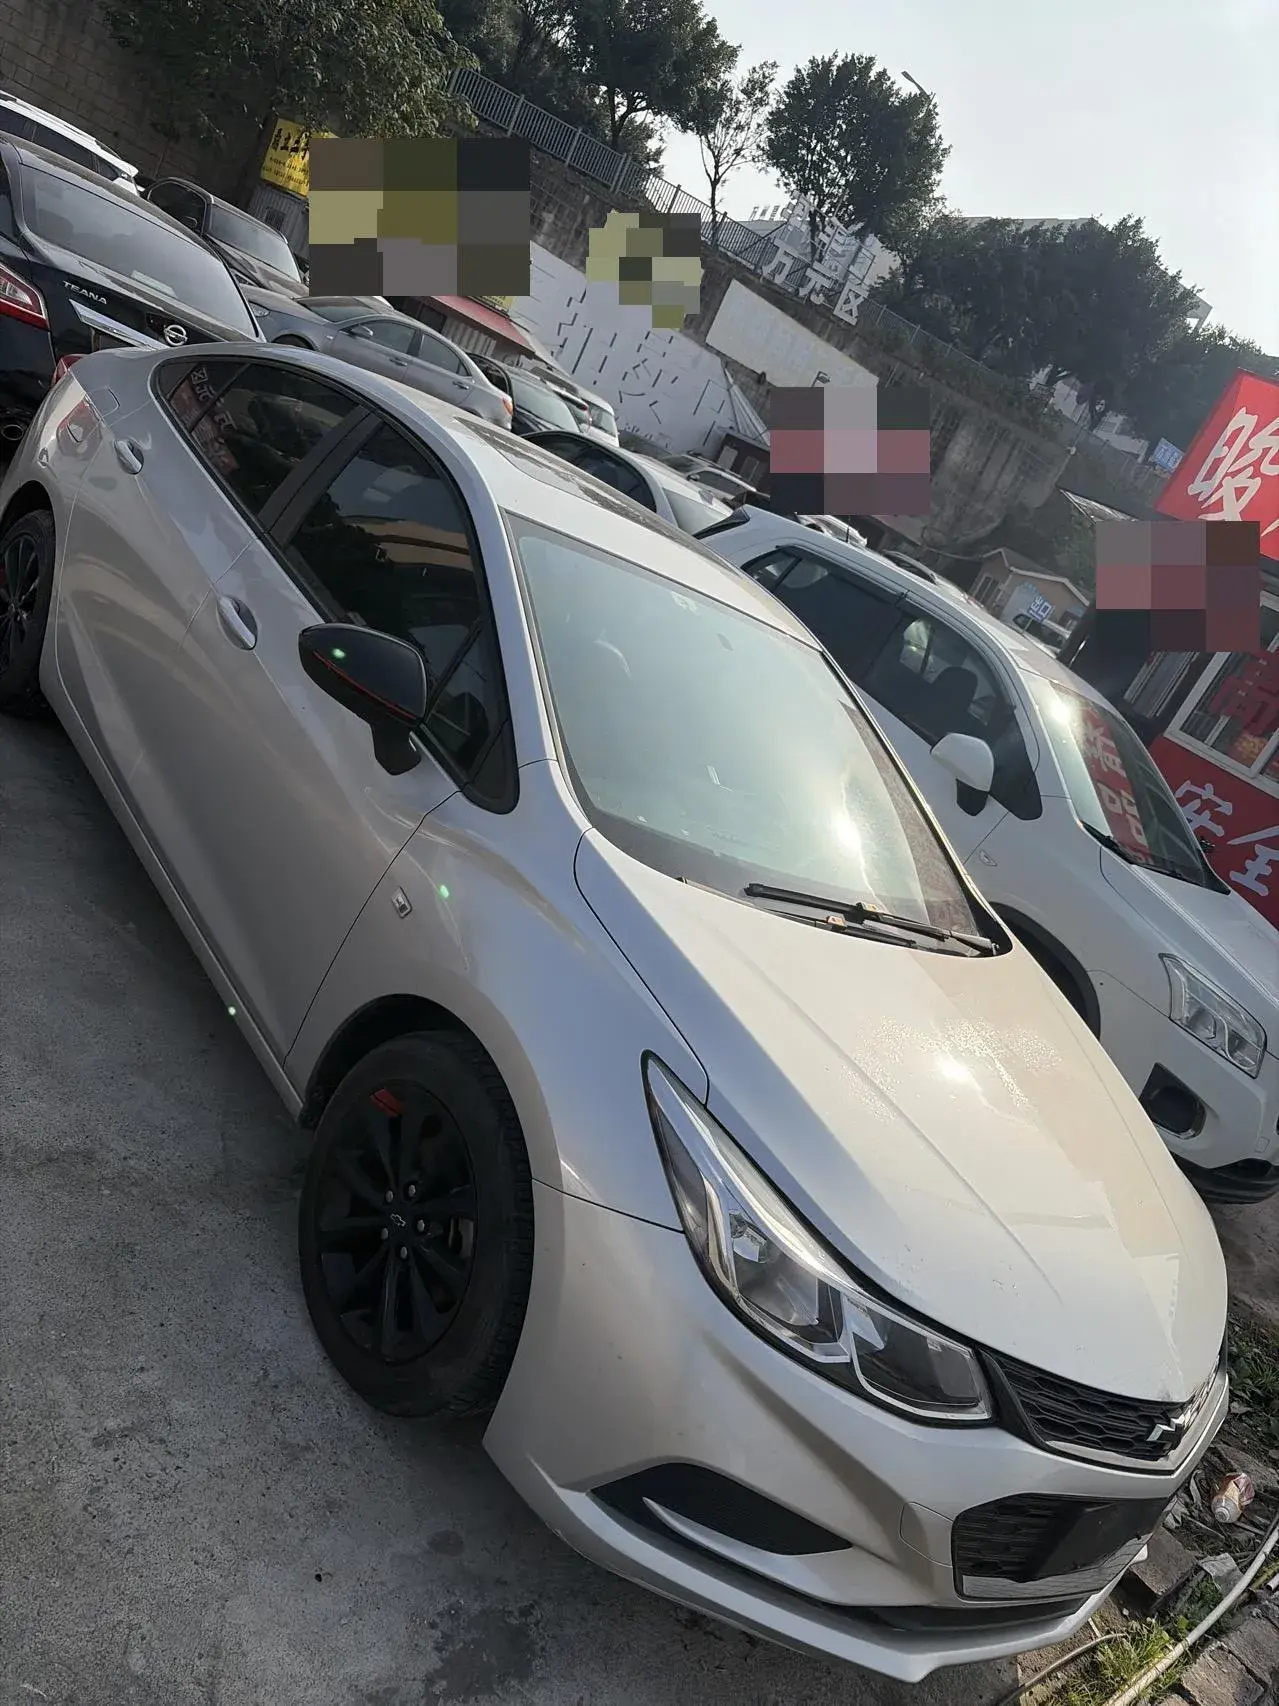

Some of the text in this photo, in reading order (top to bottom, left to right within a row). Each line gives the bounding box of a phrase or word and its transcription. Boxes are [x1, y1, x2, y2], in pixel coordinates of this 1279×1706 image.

[62, 280, 107, 305] TEANA
[762, 239, 869, 326] 万元区
